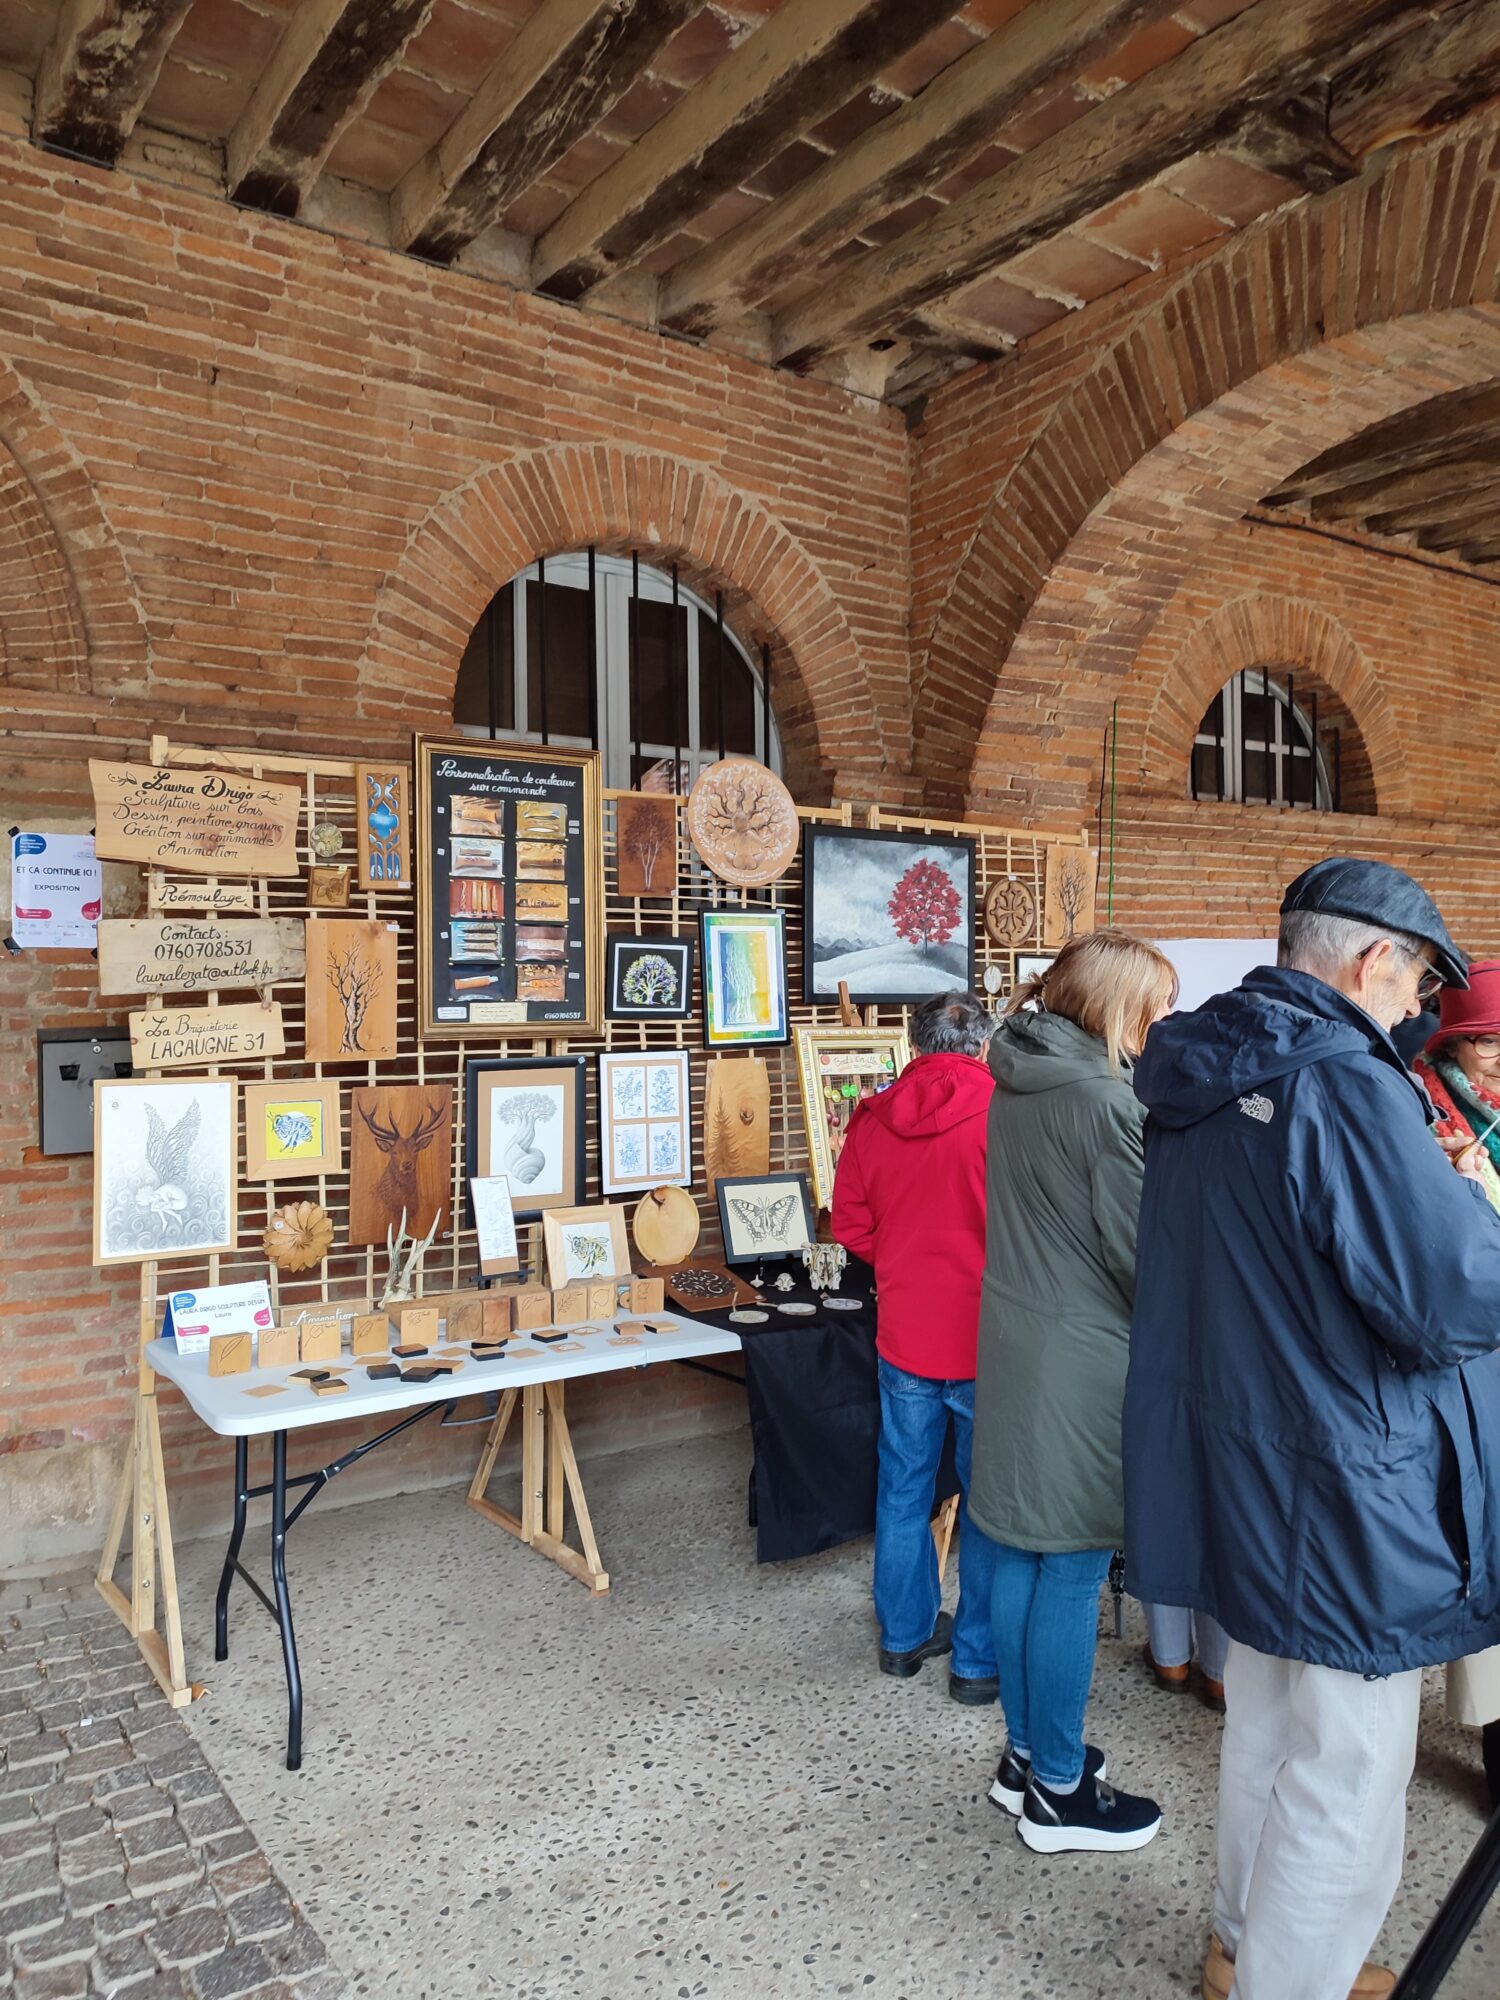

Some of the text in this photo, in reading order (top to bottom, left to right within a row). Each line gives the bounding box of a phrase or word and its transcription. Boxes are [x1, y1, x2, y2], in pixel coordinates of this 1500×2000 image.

[436, 759, 576, 787] Personnalisation de couteaux
[142, 771, 255, 804] Laura Drigo
[469, 783, 547, 796] sur commande
[124, 790, 263, 817] Sculpture sur bois
[112, 803, 173, 825] Dessin,
[123, 821, 275, 847] Création sur commande
[157, 840, 239, 859] Animation
[16, 865, 26, 874] ET
[43, 867, 81, 877] CONTINUE
[83, 869, 92, 877] ICI
[34, 884, 80, 892] EXPOSITION
[158, 884, 246, 908] Rémoulage
[160, 925, 222, 942] Contacts
[154, 939, 253, 961] 0760708531
[145, 1015, 170, 1038] La
[150, 1032, 265, 1060] LACAUGNE 31
[1237, 1096, 1263, 1112] NORTH
[1251, 1093, 1266, 1104] THE
[1240, 1105, 1260, 1119] FACE
[179, 1308, 199, 1316] LAURA
[199, 1305, 217, 1313] DRIGO
[217, 1301, 247, 1311] SCULPTURE
